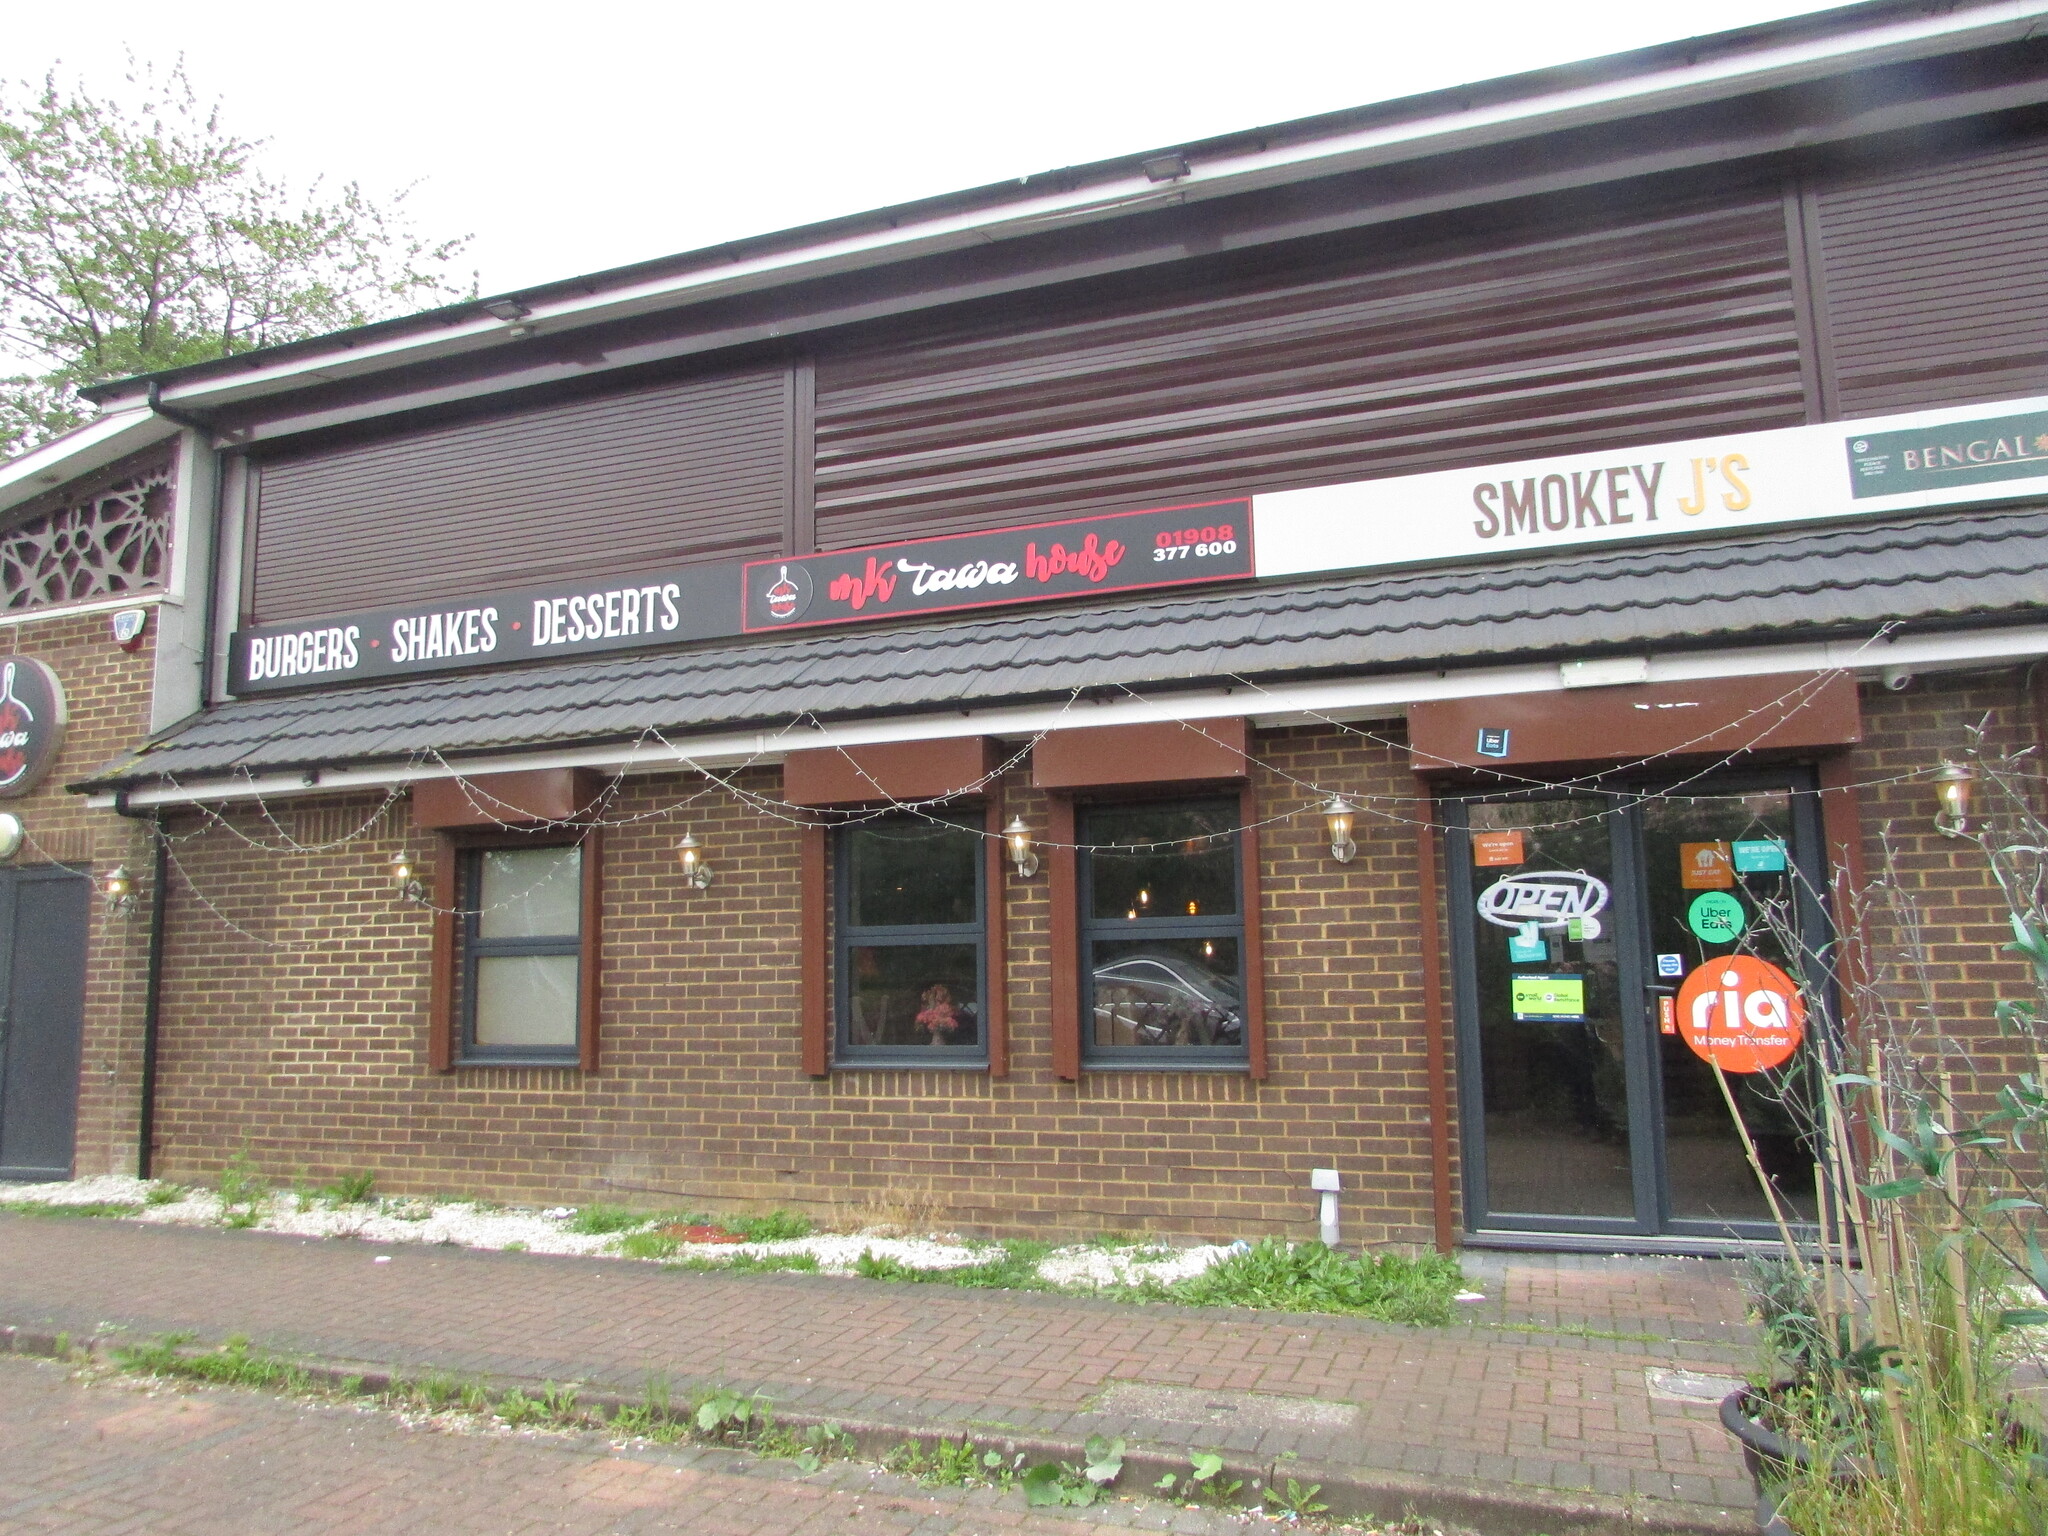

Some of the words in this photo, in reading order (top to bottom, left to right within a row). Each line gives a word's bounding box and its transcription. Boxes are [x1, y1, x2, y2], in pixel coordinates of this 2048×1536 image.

[1903, 435, 2033, 471] BENGAL
[1473, 462, 1665, 539] SMOKEY
[1677, 453, 1752, 516] J'S
[1153, 545, 1191, 562] 377
[1194, 540, 1238, 558] 600
[1156, 524, 1235, 548] 01908
[1025, 532, 1126, 583] house
[248, 625, 361, 682] BURGERS
[392, 607, 499, 663] SHAKES
[532, 583, 682, 647] DESSERTS
[1486, 882, 1594, 917] OPEN
[1700, 907, 1731, 918] Uber
[1702, 918, 1733, 929] Eats
[1692, 970, 1788, 1028] ria
[1694, 1035, 1736, 1048] Money
[1737, 1034, 1788, 1046] Transfer
